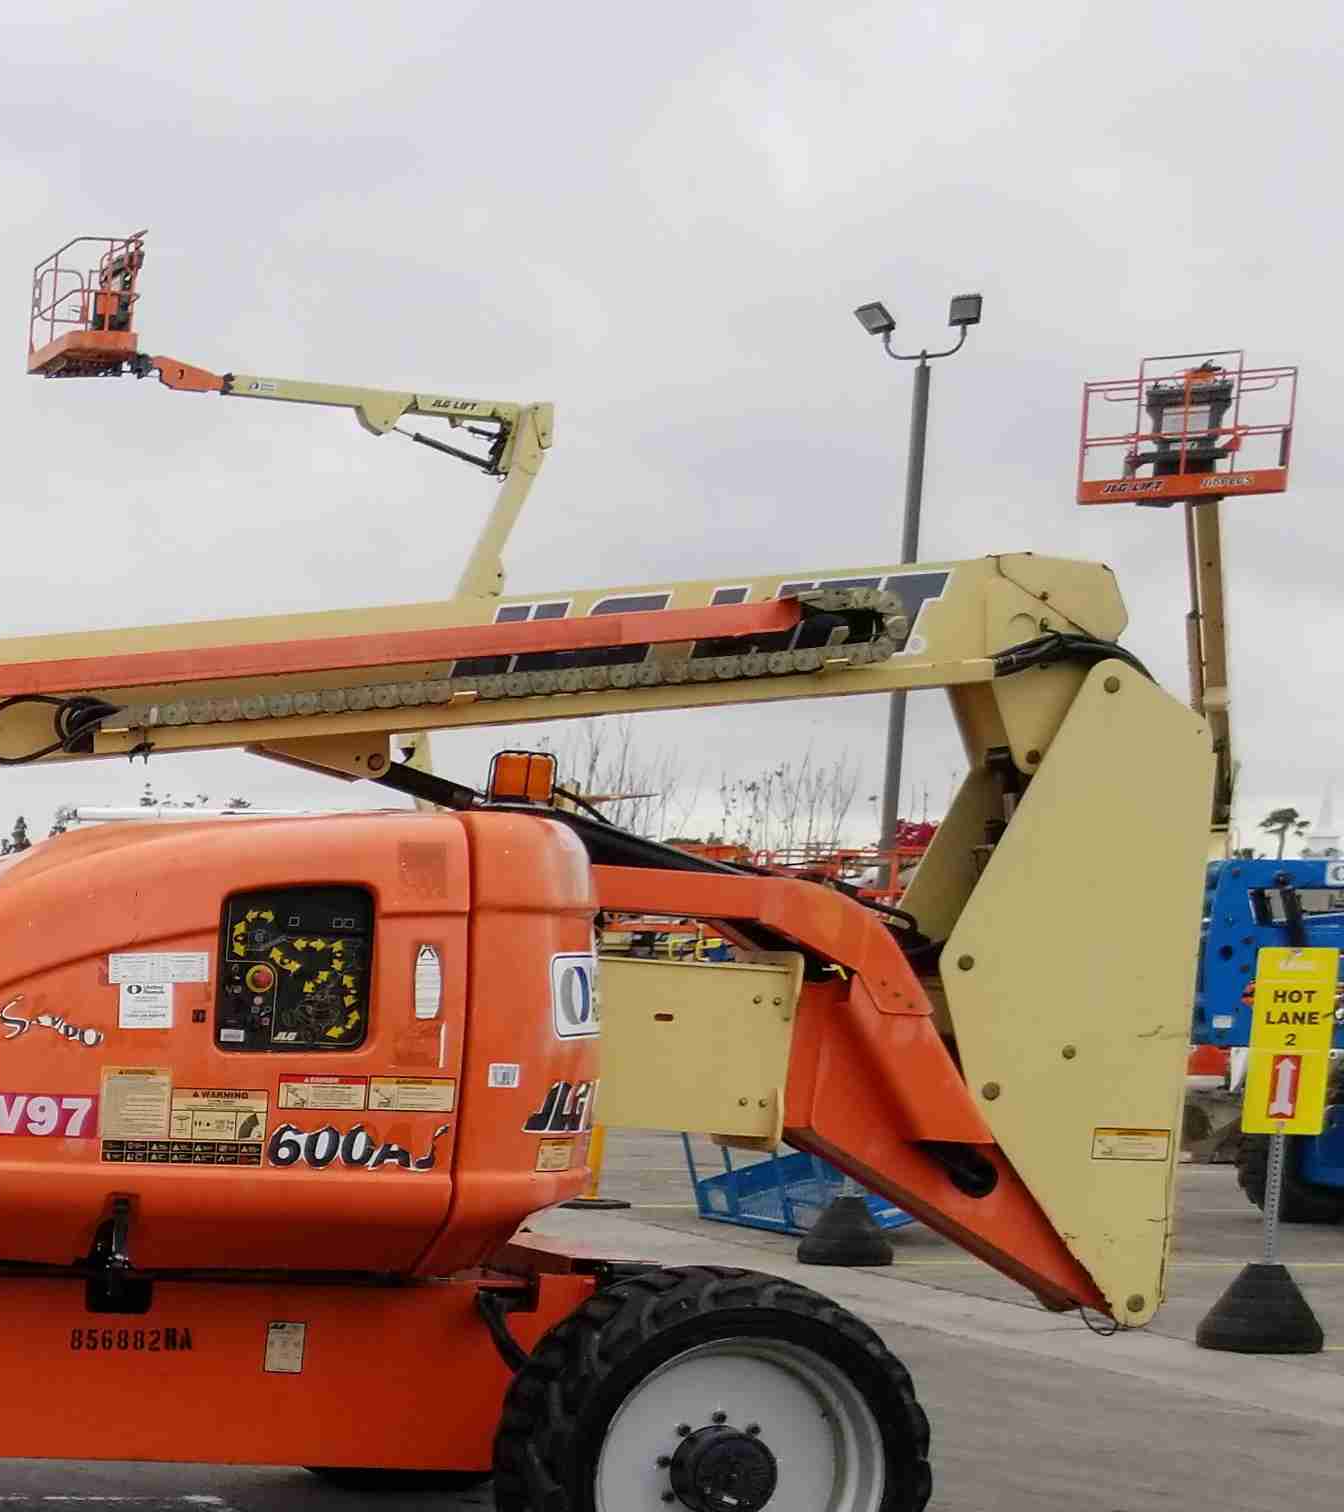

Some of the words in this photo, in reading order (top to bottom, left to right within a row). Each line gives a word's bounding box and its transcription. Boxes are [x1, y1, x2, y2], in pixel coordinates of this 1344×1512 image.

[1272, 989, 1317, 1004] HOT
[1264, 1011, 1321, 1025] LANE
[274, 1031, 298, 1041] JLG
[1284, 1032, 1297, 1047] 2
